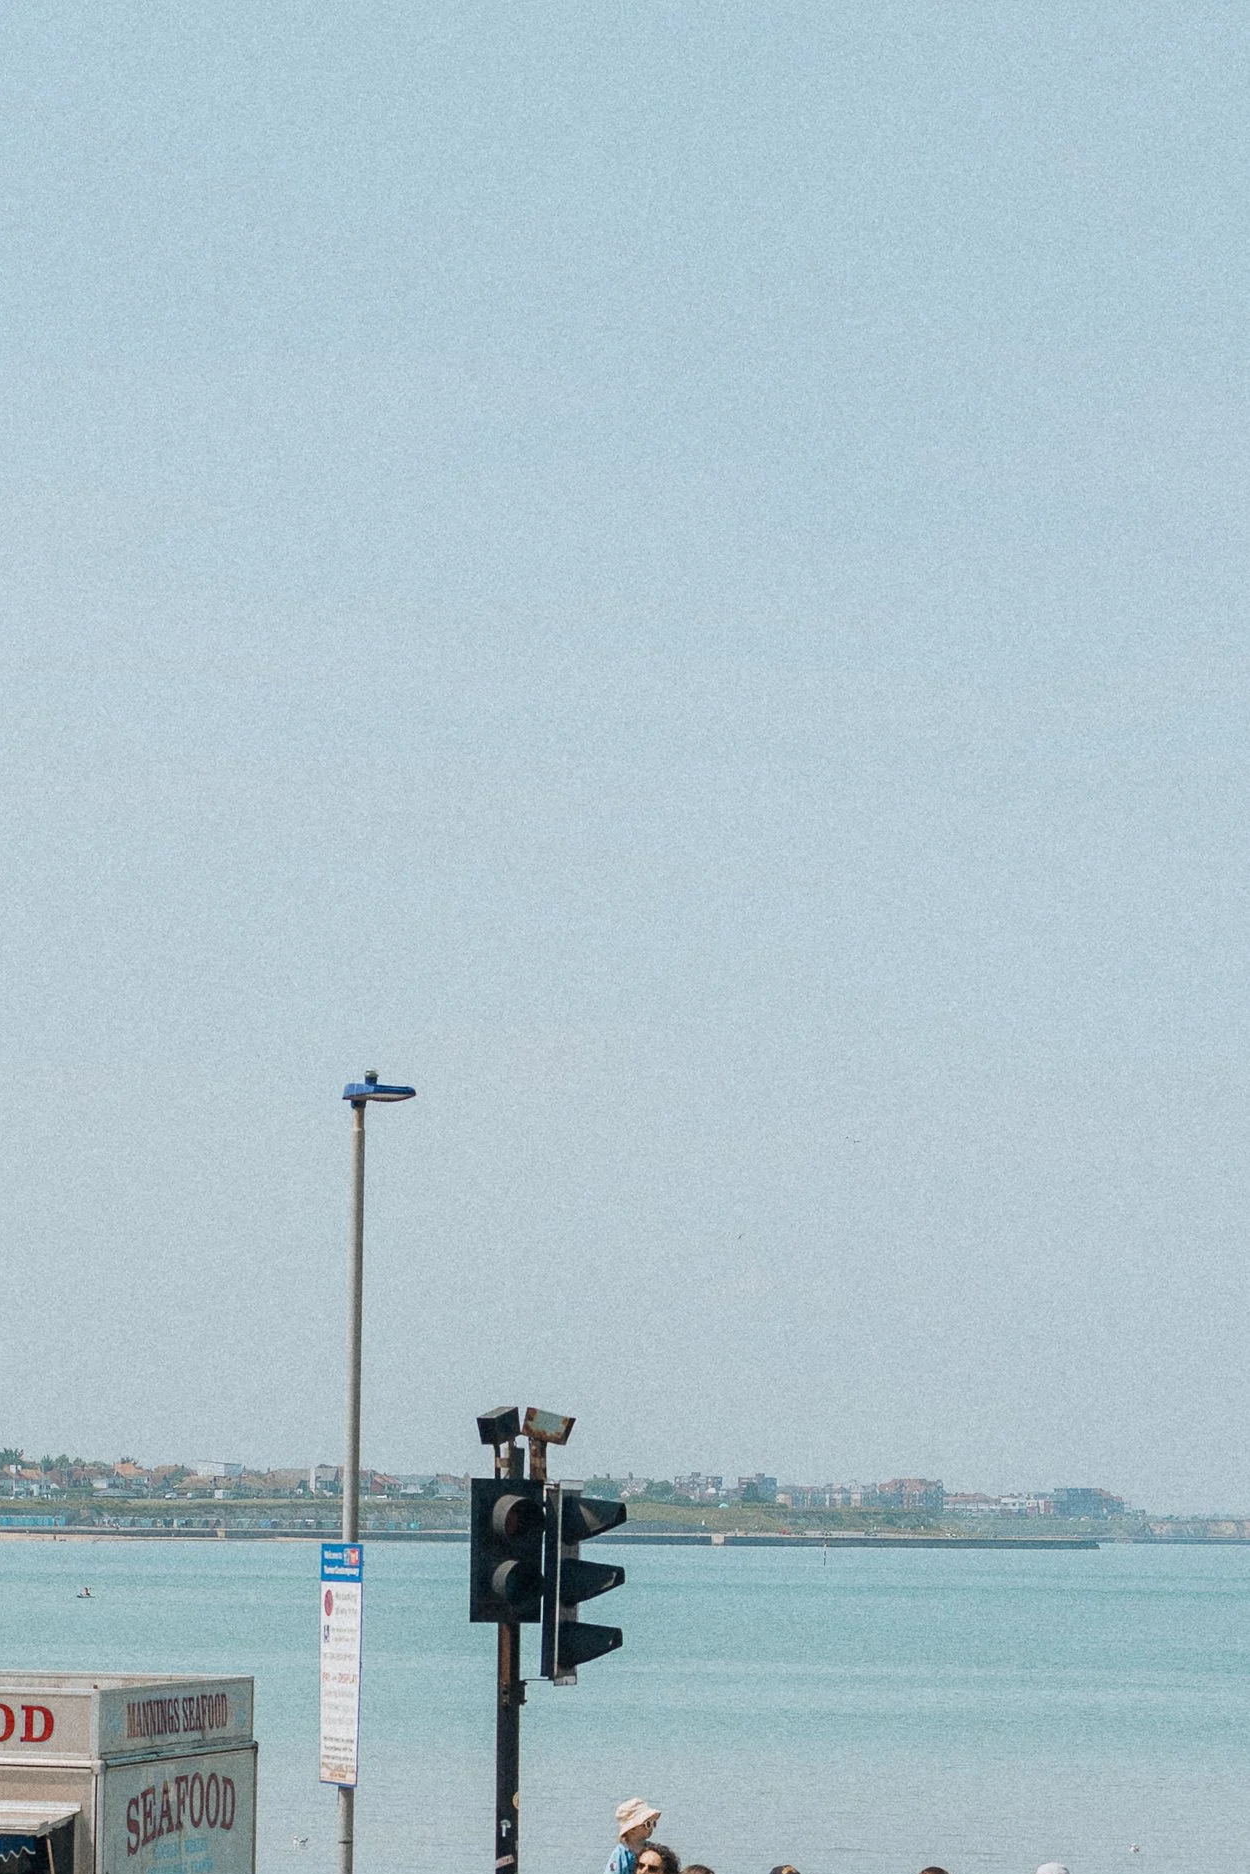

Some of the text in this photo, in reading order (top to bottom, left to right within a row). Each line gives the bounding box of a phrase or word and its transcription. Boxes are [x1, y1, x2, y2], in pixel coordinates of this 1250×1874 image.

[126, 1693, 228, 1738] MANNINGS SEAFOOD
[126, 1771, 236, 1857] SEAFOOD
